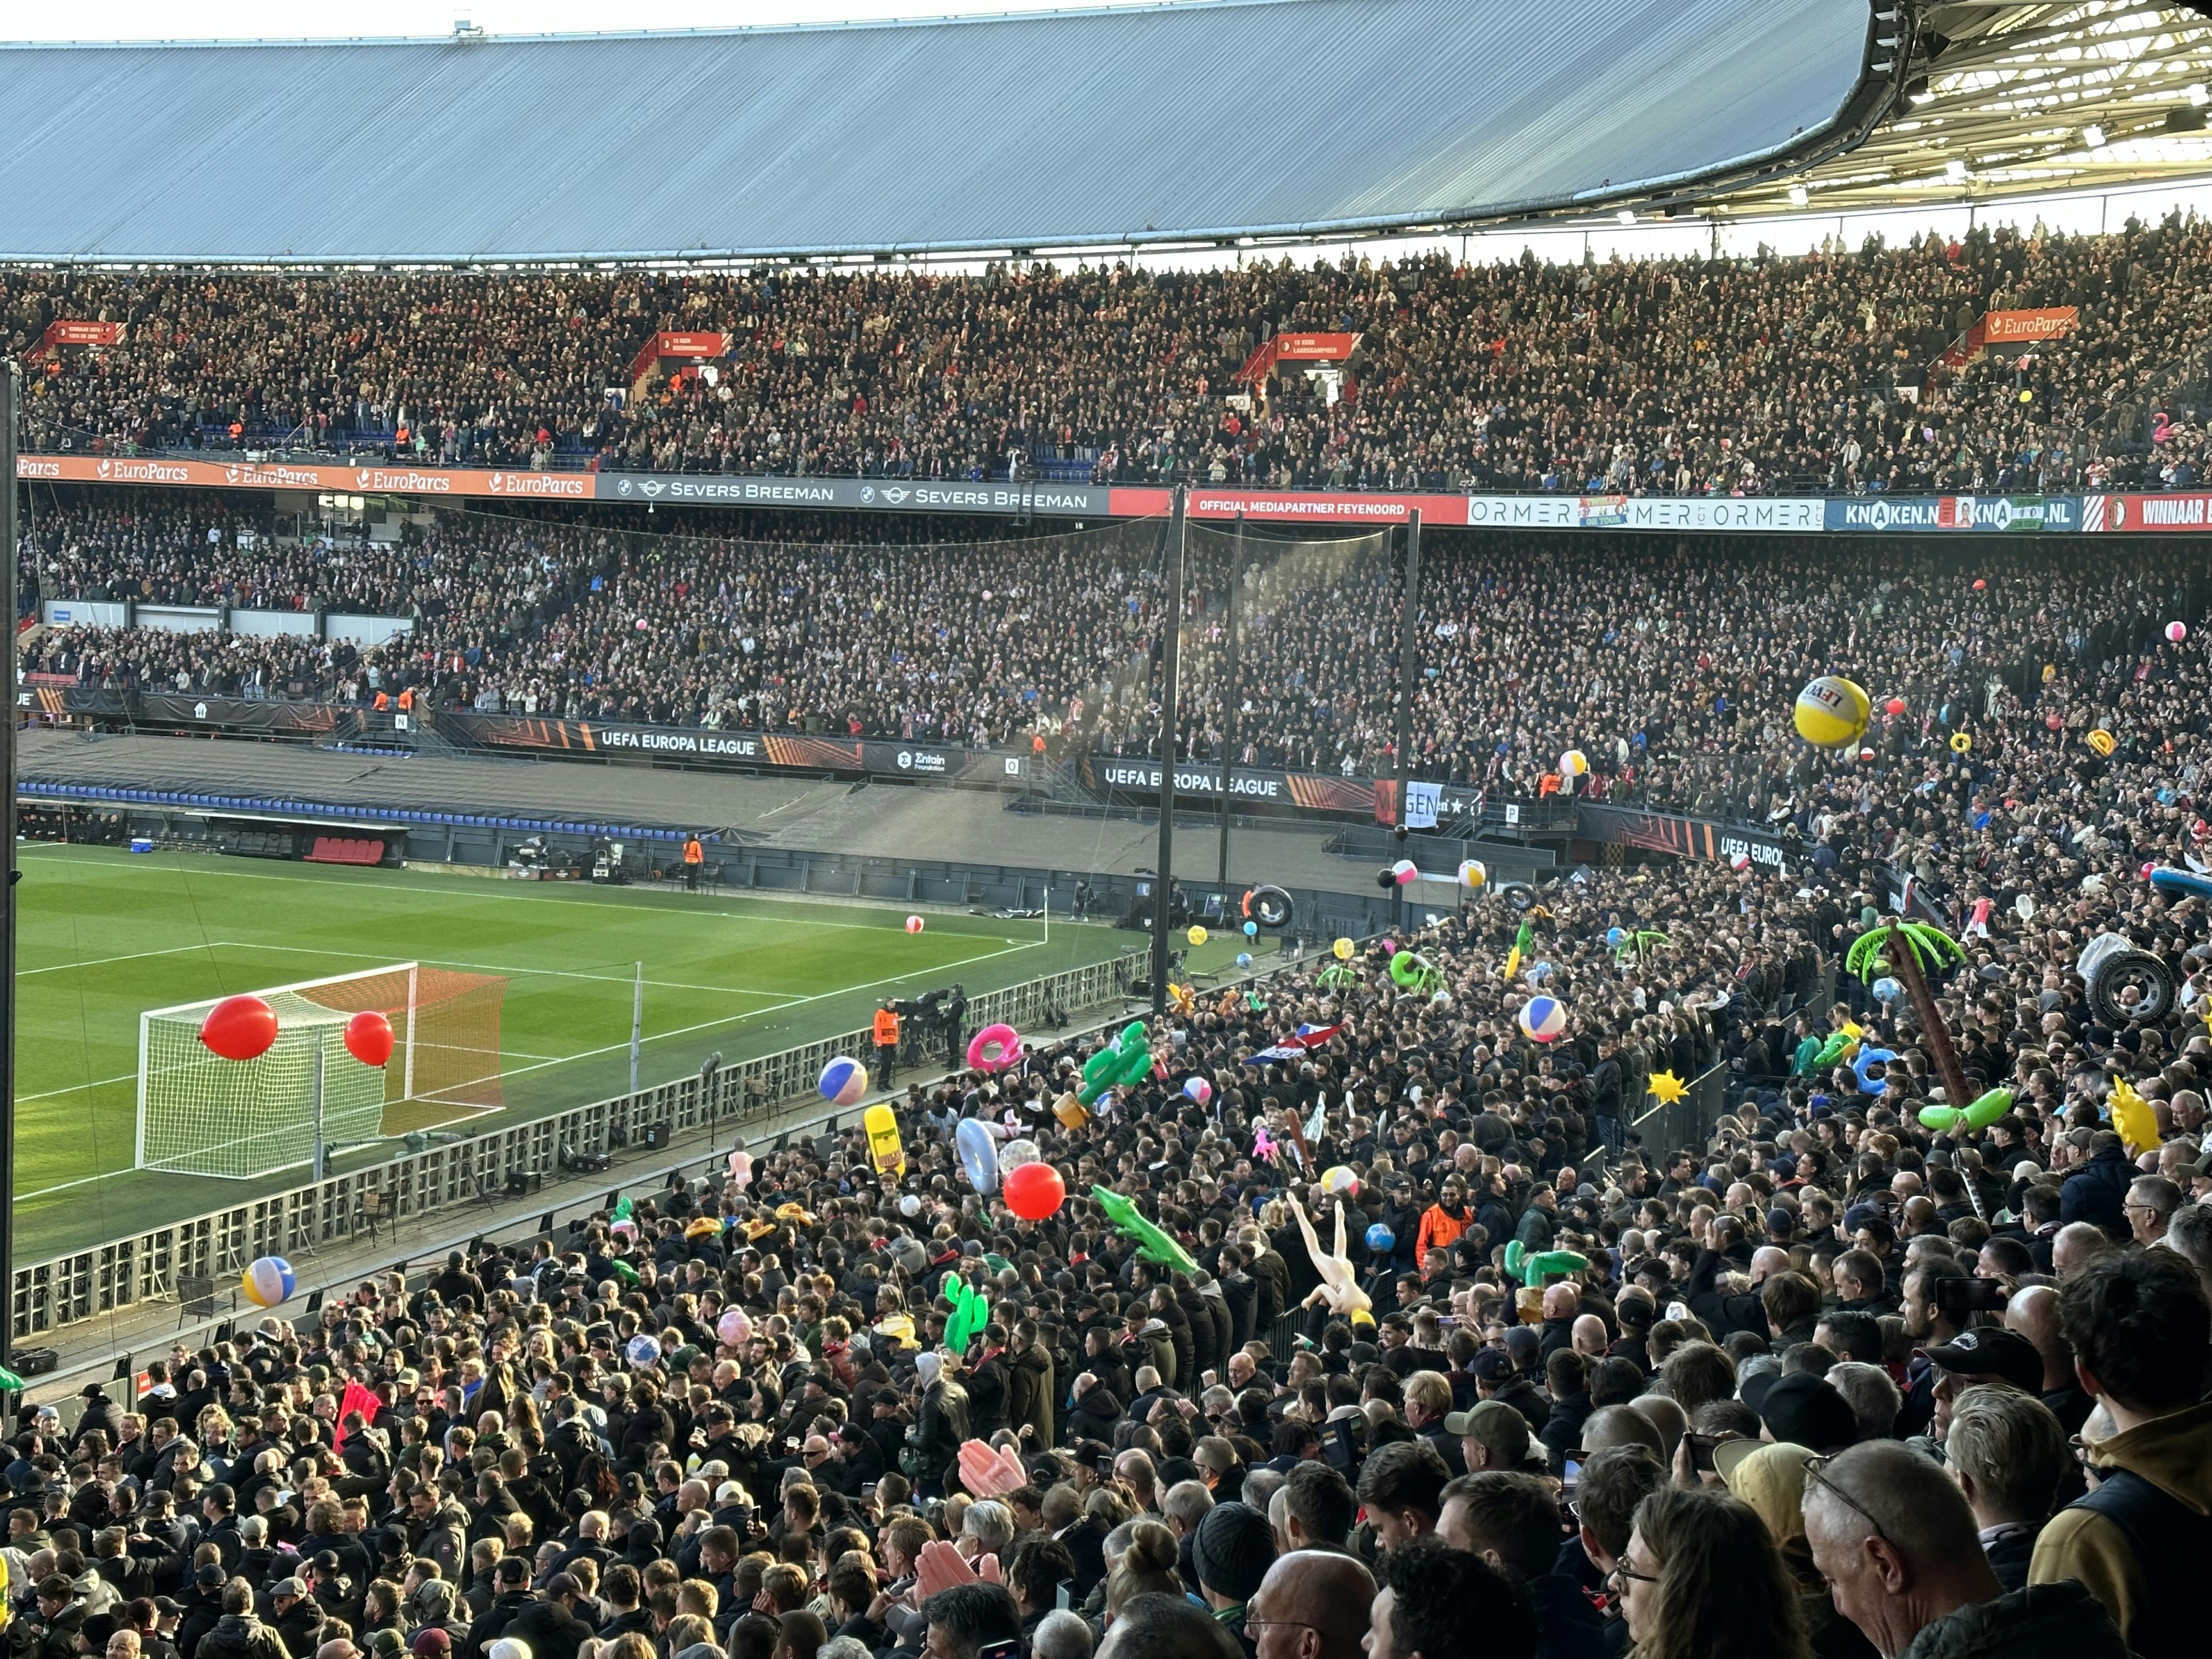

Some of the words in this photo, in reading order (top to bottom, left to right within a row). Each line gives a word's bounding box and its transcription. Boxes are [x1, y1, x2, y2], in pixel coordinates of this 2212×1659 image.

[2004, 317, 2072, 334] EuroParcs
[114, 461, 188, 481] EuroParcs
[242, 466, 317, 485] EuroParcs
[373, 472, 449, 491] EuroParcs
[505, 476, 583, 493] EuroParcs
[670, 482, 740, 497] SEVERS
[746, 485, 833, 500] BREEMAN
[916, 489, 988, 505] SEVERS
[995, 492, 1086, 508] BREEMAN
[1200, 500, 1248, 512] OFFICIAL
[1250, 501, 1334, 514] MEDIAPARTNER
[1338, 503, 1405, 515] FEYENOORD
[1472, 502, 1570, 523] ORMER
[1714, 504, 1809, 525] ORMER
[1846, 505, 1939, 525] KNAKEN.N
[2143, 499, 2204, 524] WINNAAR
[1805, 685, 1842, 707] LEVO
[602, 732, 638, 746] UEFA
[642, 735, 696, 751] EUROPA
[700, 739, 754, 755] LEAGUE
[1105, 769, 1147, 785] UEFA
[1509, 808, 1515, 819] P
